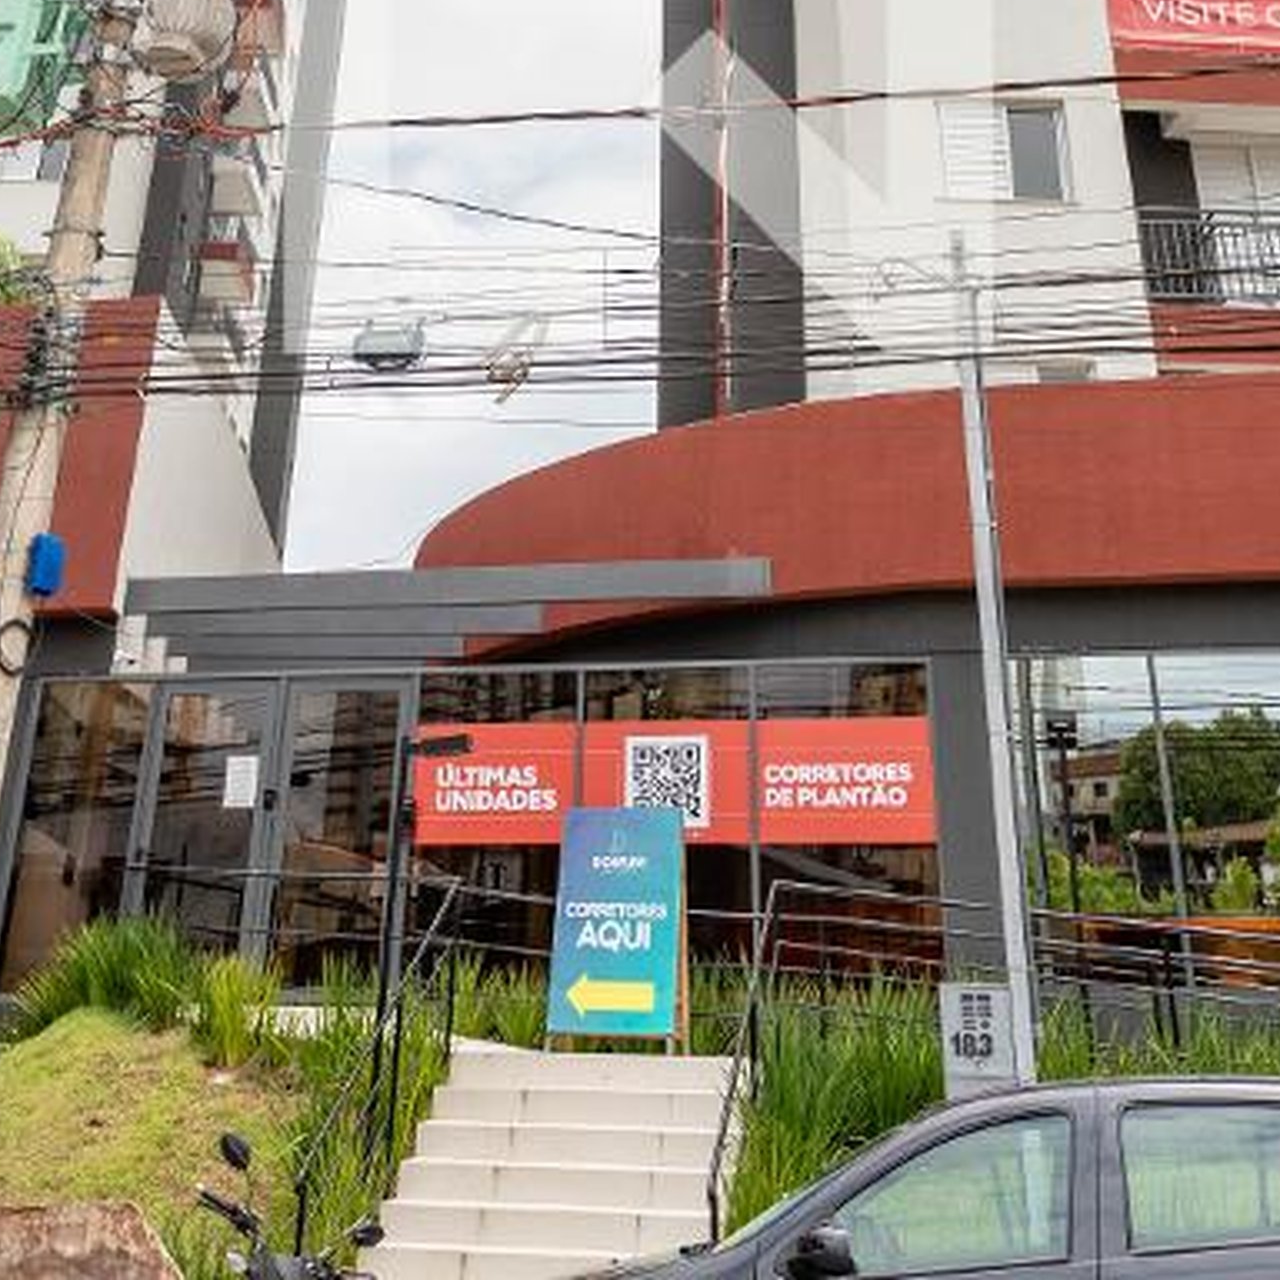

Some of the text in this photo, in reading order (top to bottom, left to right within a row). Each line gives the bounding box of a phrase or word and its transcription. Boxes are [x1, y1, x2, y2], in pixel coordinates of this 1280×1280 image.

[1143, 0, 1257, 26] VISITE
[438, 763, 538, 788] ÚLTIMAS
[765, 762, 913, 784] CORRETORES
[436, 789, 558, 811] UNIDADES
[766, 783, 907, 807] DE PLANTÃO
[576, 920, 651, 952] AQUI
[950, 1032, 993, 1059] 183
